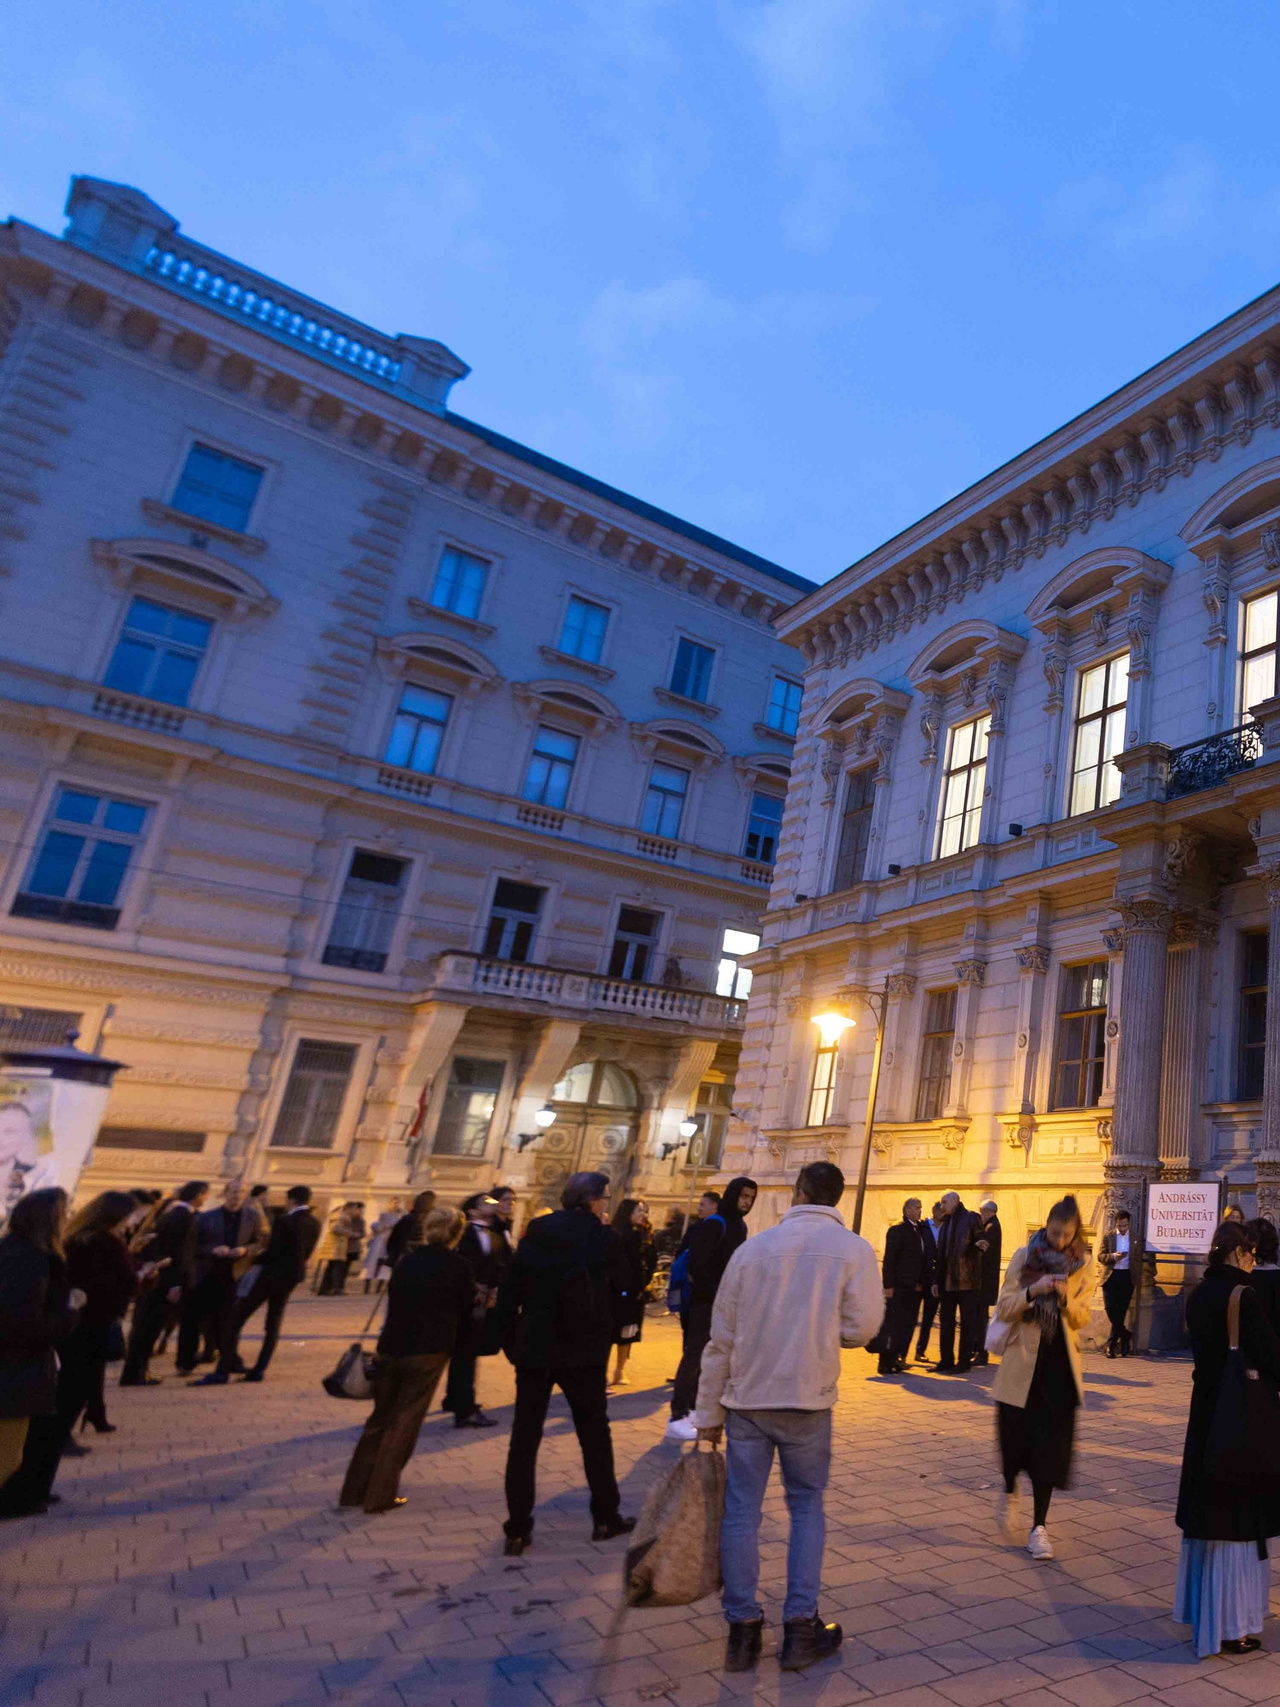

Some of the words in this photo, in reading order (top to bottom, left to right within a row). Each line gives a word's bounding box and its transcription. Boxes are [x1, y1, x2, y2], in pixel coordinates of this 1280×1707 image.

[1158, 1191, 1207, 1204] ANDRÁSSY
[1151, 1208, 1214, 1221] UNIVERSITÄT
[1156, 1225, 1206, 1239] BUDAPEST
